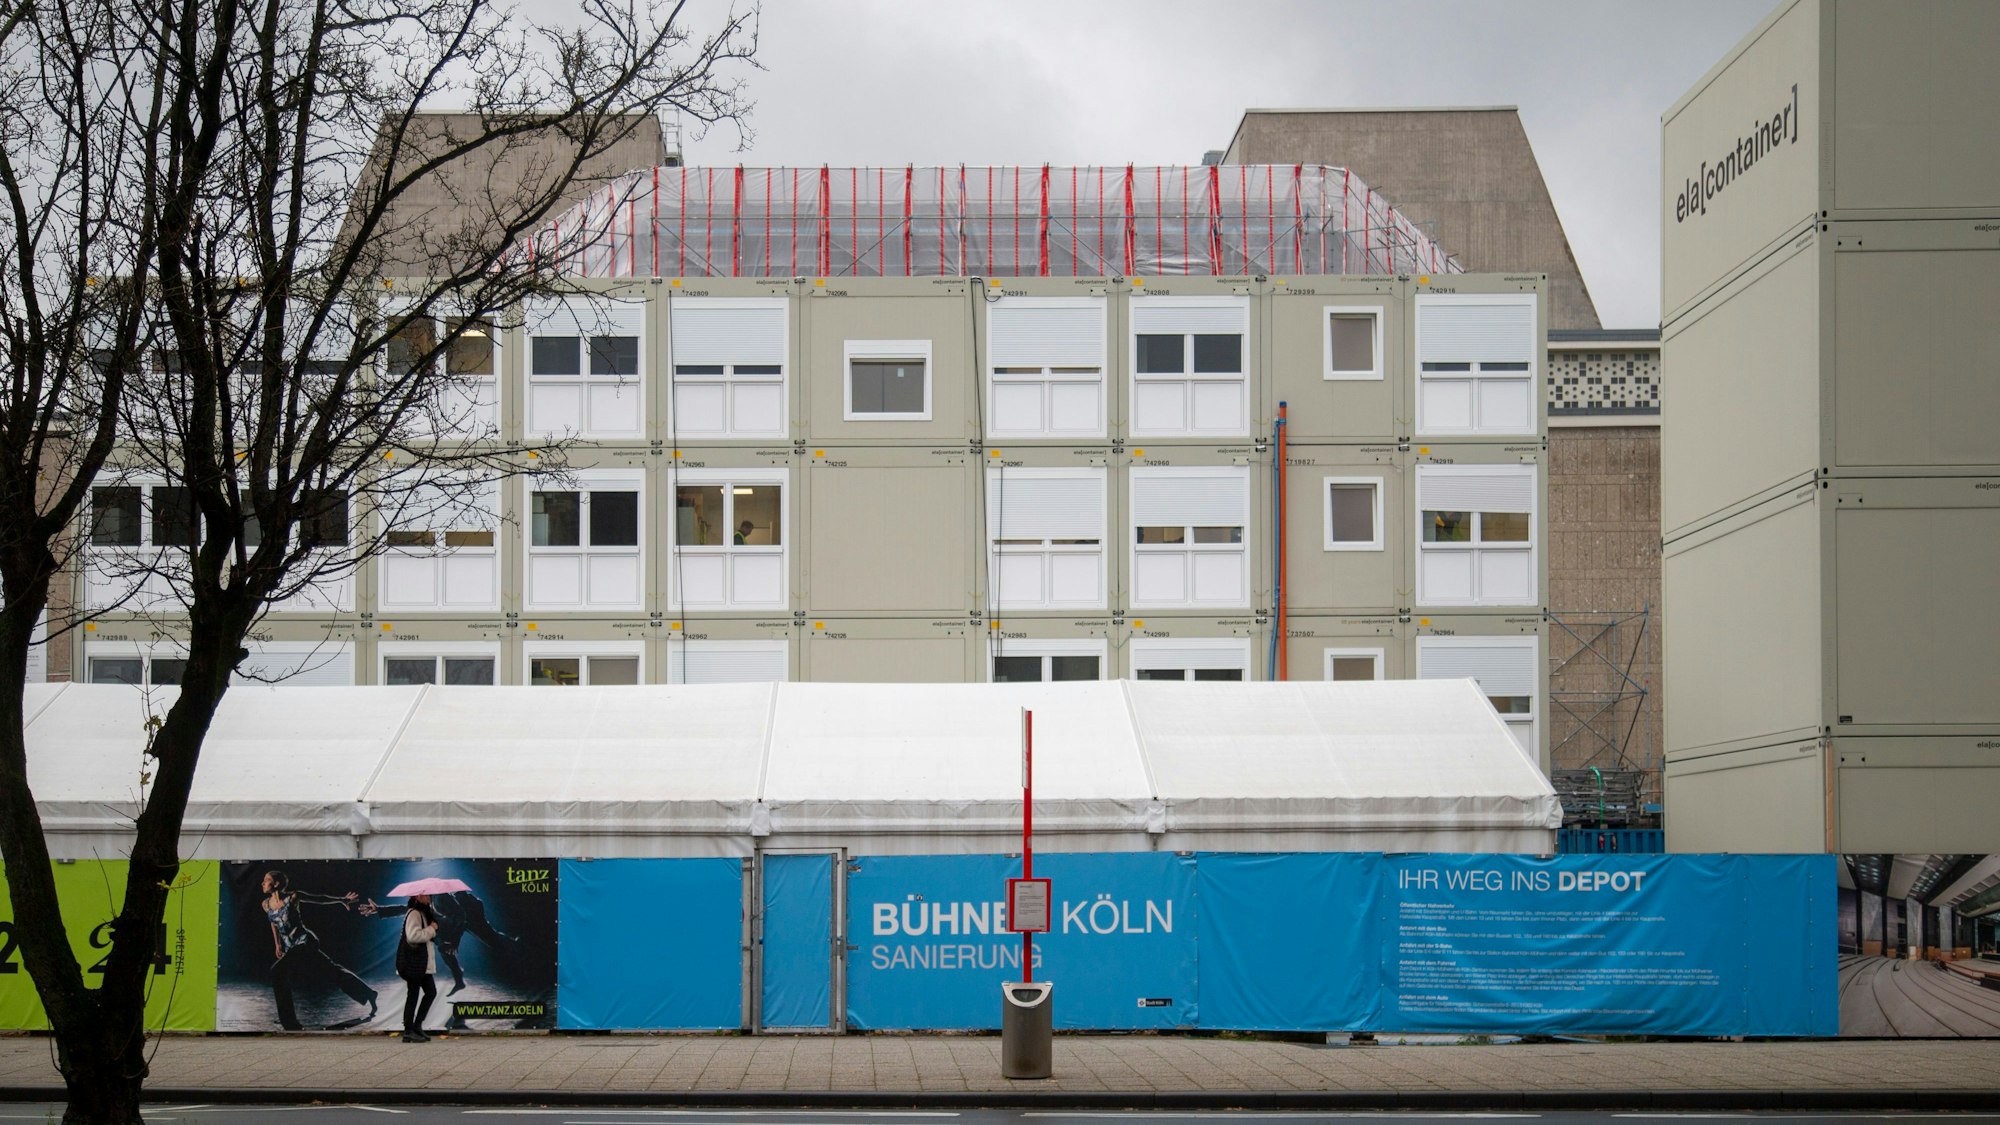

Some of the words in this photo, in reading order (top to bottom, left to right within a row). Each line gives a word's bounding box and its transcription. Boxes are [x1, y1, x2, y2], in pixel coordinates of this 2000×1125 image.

[1676, 83, 1798, 224] ela[container]
[506, 867, 550, 885] tanz
[521, 882, 550, 893] KÖLN
[1398, 869, 1439, 890] IHR
[1445, 870, 1504, 891] WEG
[1511, 871, 1551, 892] INS
[1558, 871, 1647, 893] DEPOT
[873, 894, 1047, 936] BÜHNE
[1063, 894, 1172, 934] KÖLN
[175, 929, 185, 975] SPIELZEIT
[871, 944, 1042, 970] SANIERUNG
[457, 1005, 544, 1015] WWW.TANZ.KOELN
